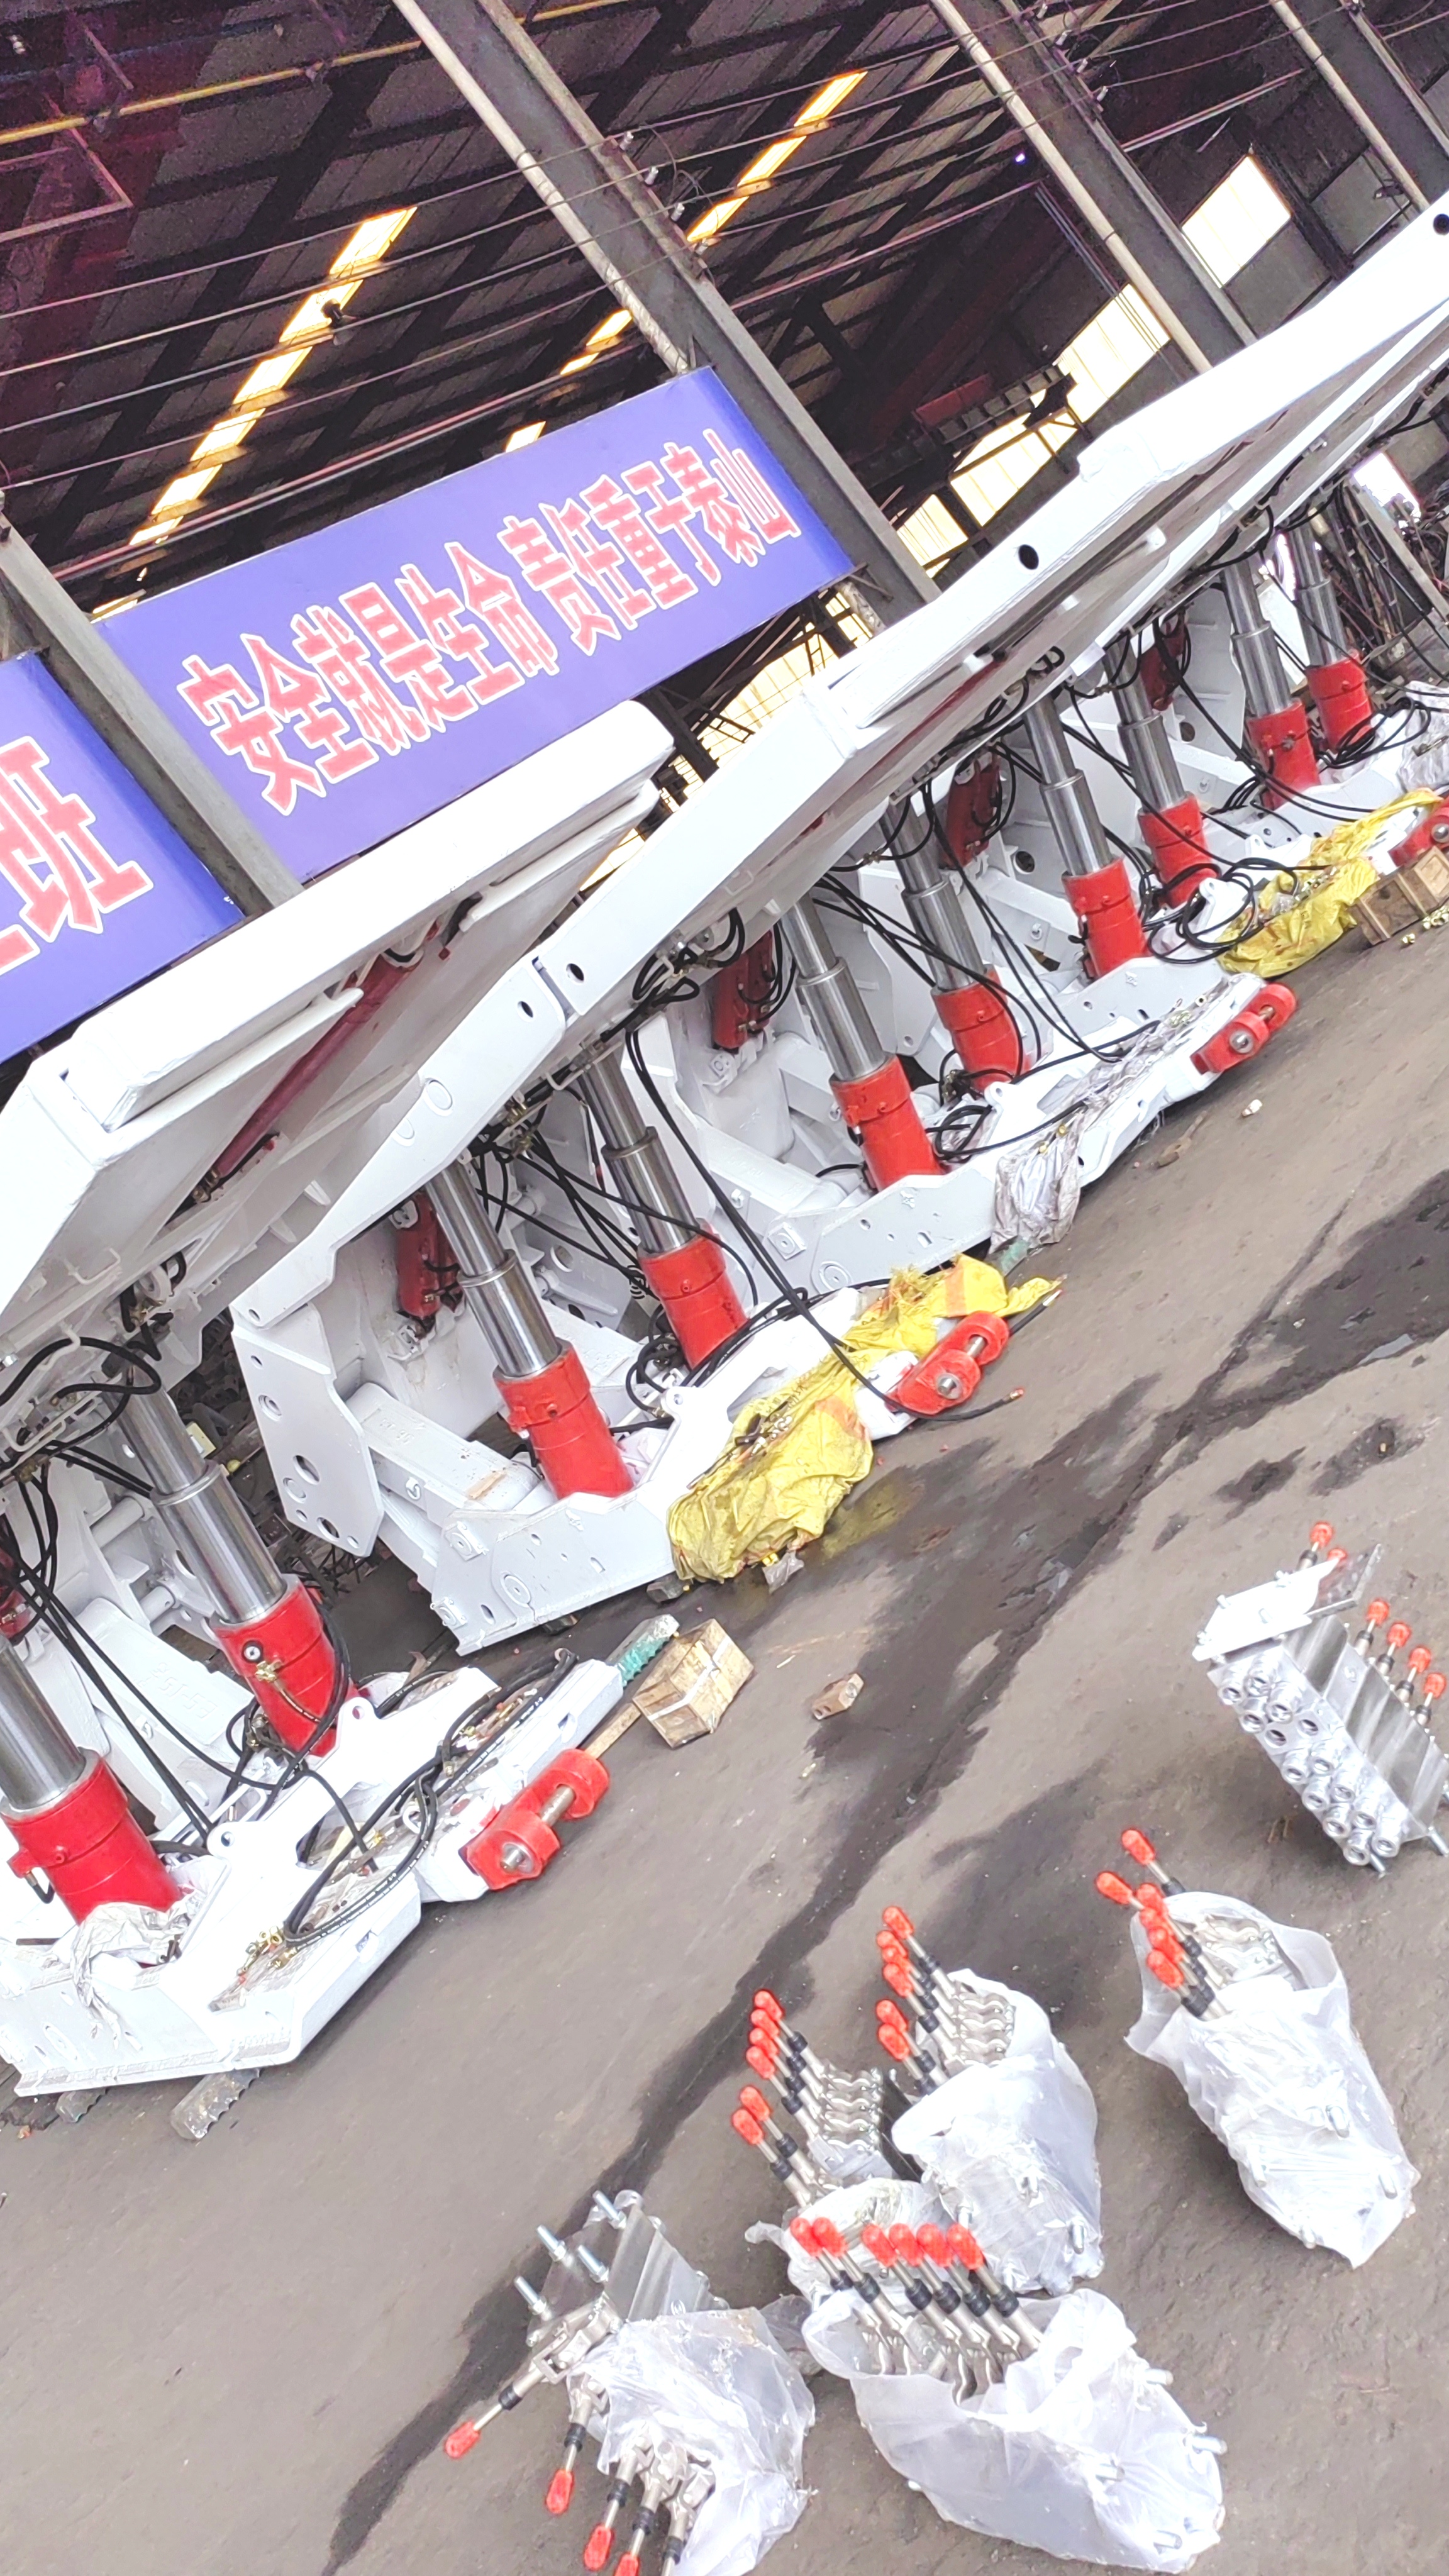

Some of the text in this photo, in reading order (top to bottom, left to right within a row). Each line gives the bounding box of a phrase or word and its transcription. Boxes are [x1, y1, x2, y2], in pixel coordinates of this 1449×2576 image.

[177, 428, 802, 815] 安全就是生命 责任重于泰山
